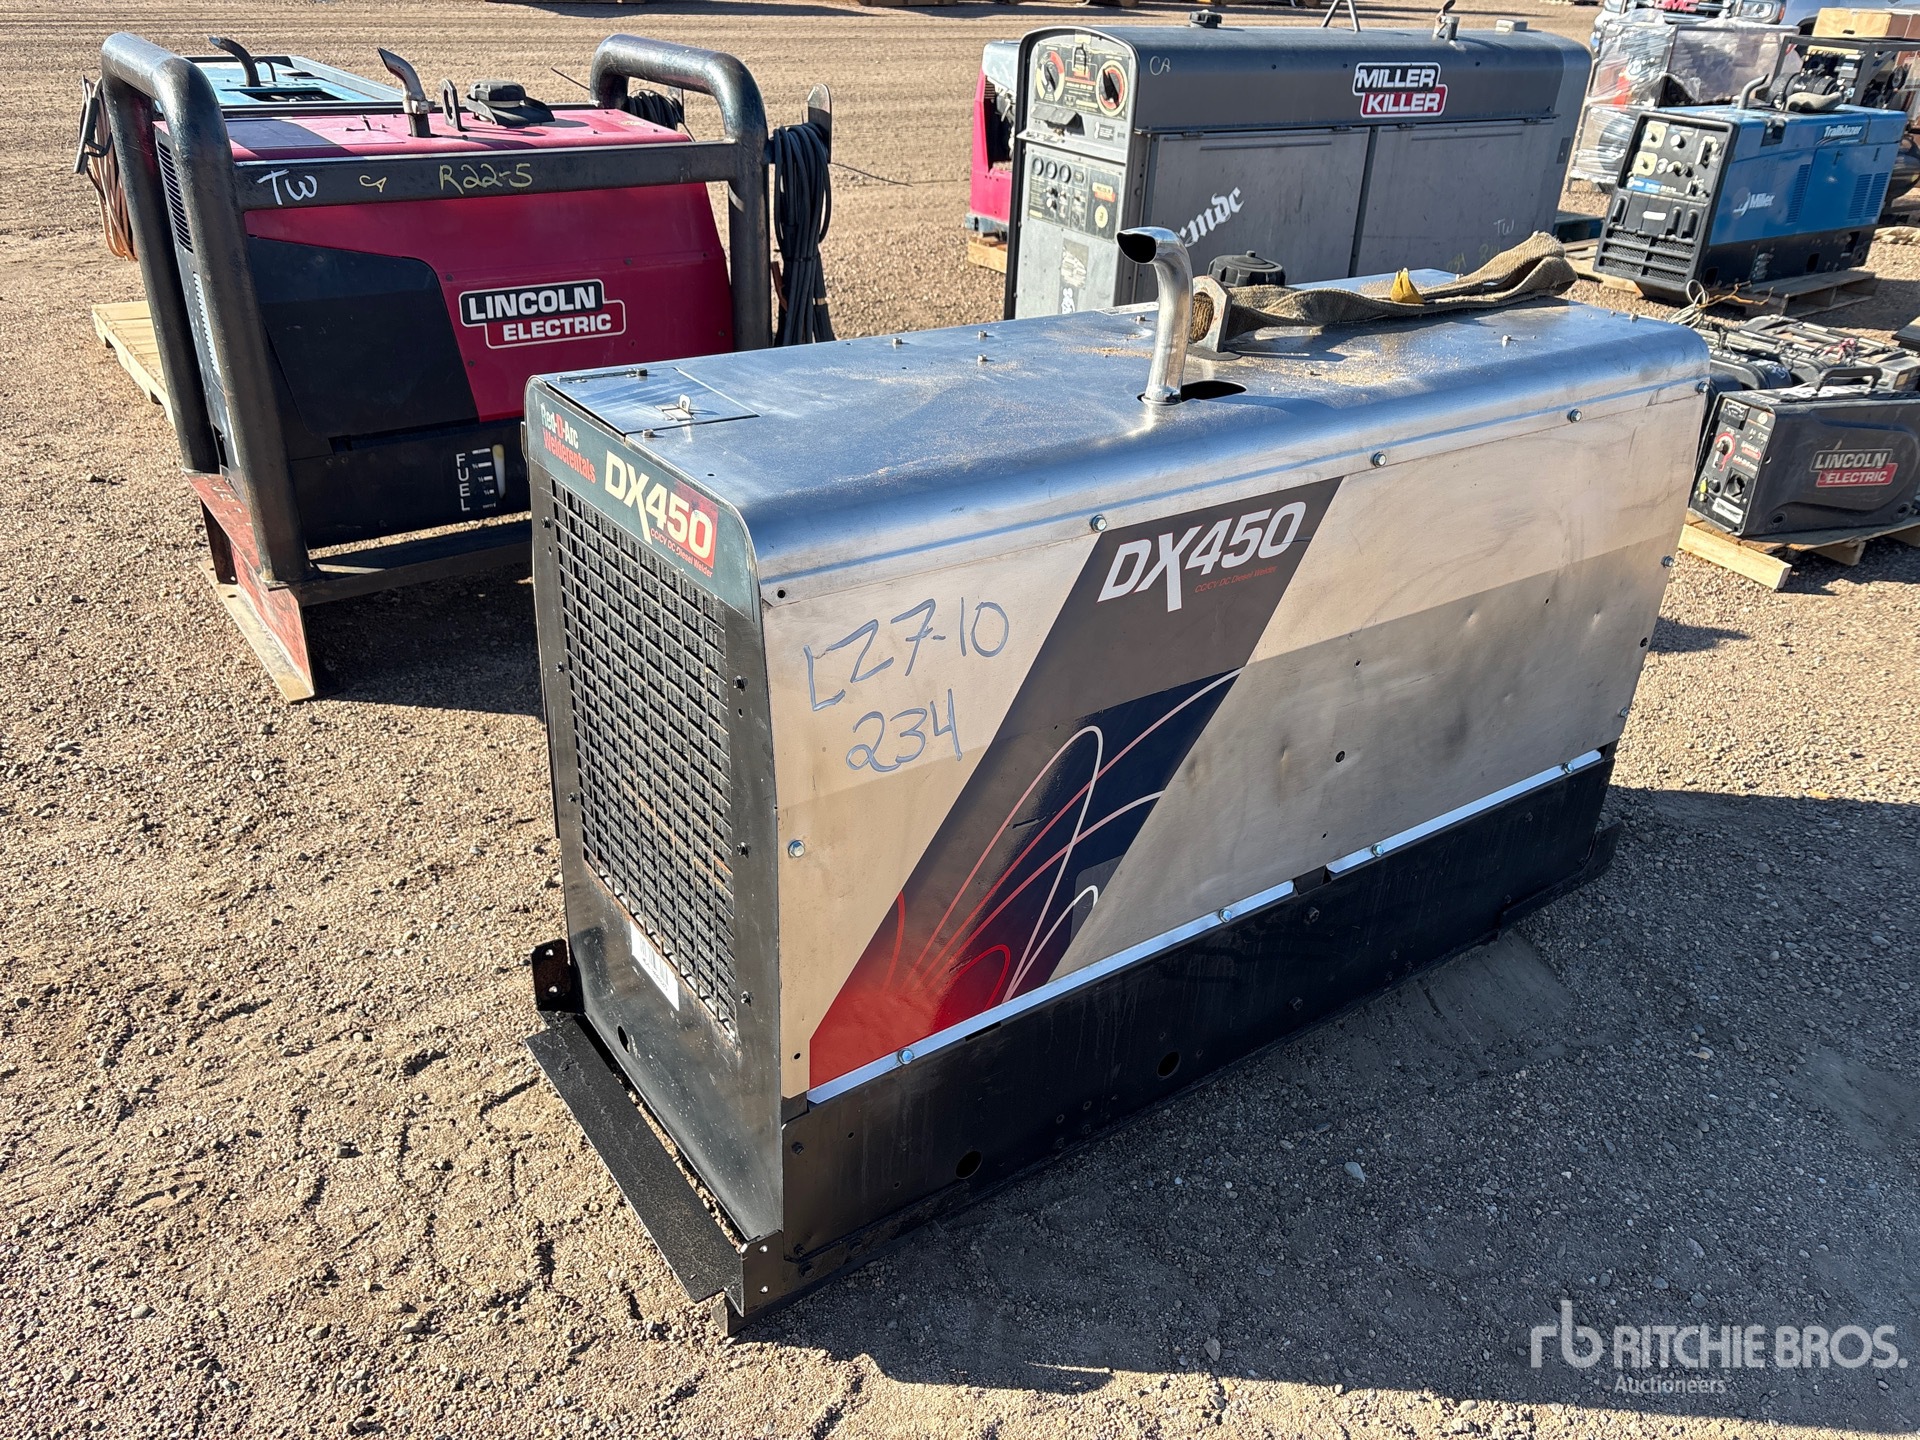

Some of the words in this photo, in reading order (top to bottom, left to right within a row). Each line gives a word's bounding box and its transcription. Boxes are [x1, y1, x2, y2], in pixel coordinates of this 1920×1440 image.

[1356, 68, 1436, 88] MILLER
[1366, 93, 1441, 113] KILLER
[257, 169, 318, 206] TW
[439, 164, 533, 195] R22-5
[1749, 194, 1775, 207] Miller
[468, 286, 596, 321] LINCOLN
[502, 313, 612, 341] ELECTRIC
[540, 402, 579, 449] Red-D-Arc
[543, 427, 597, 484] Welderentals
[1814, 451, 1888, 470] LINCOLN
[456, 452, 471, 512] FUEL
[1826, 470, 1888, 484] ELECTRIC
[604, 450, 713, 559] DX450
[693, 557, 713, 578] Welder
[1097, 501, 1307, 612] DX450
[846, 688, 963, 773] 234
